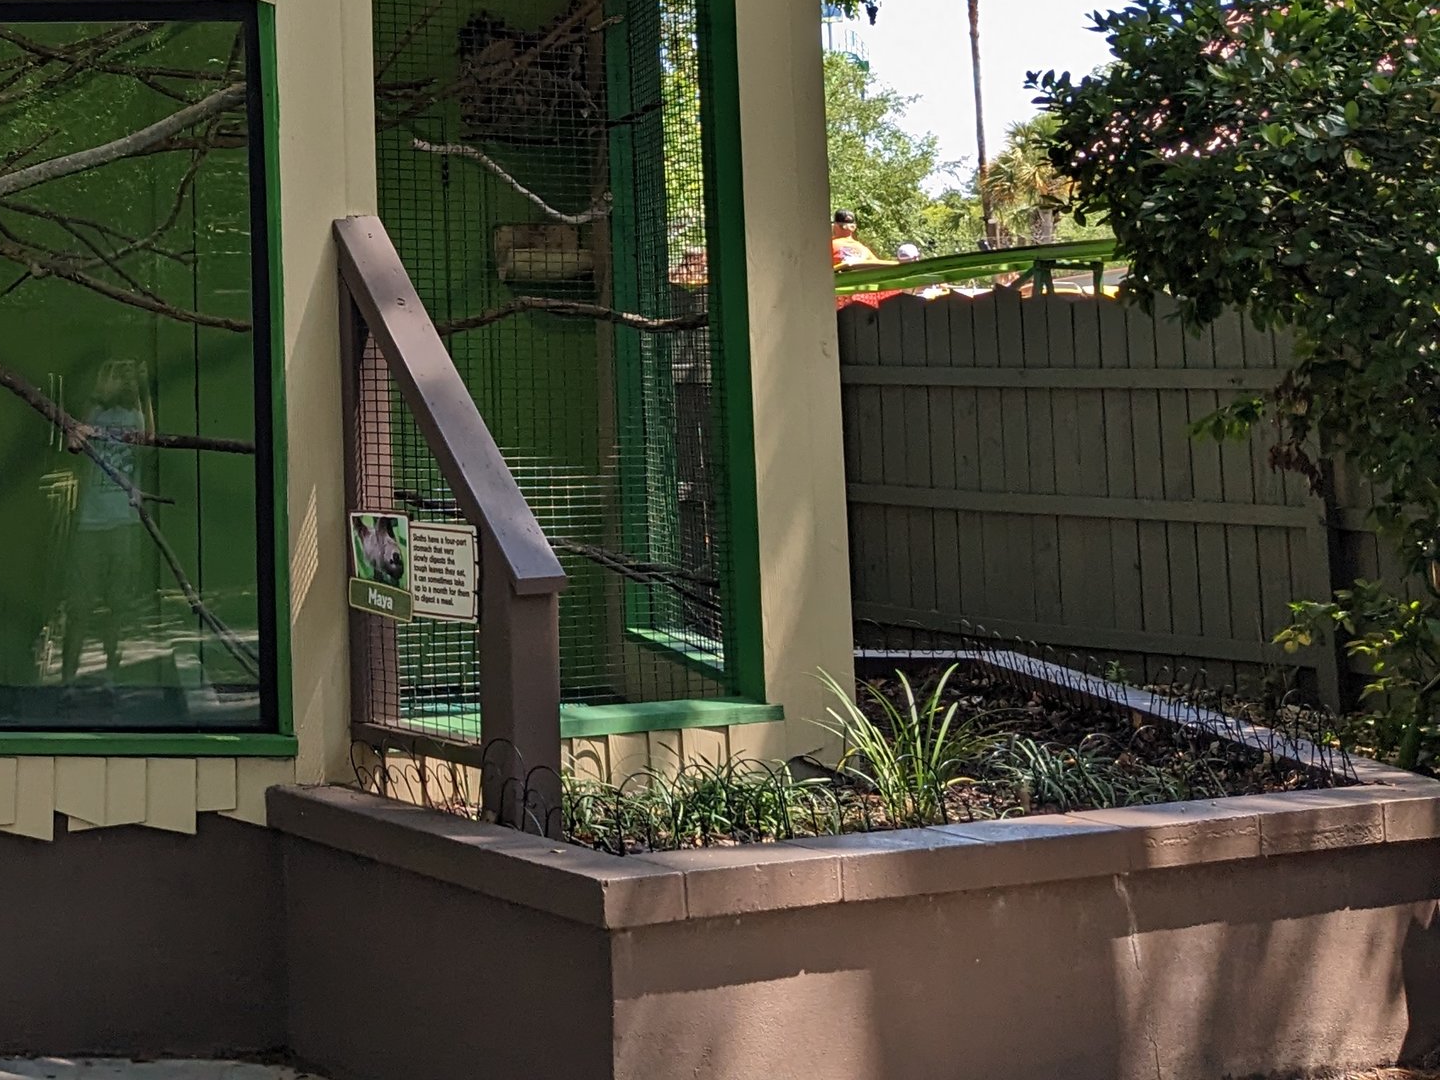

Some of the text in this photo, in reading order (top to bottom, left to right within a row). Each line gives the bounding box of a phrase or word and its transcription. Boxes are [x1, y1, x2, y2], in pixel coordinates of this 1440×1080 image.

[413, 534, 426, 542] Sloths
[428, 535, 439, 543] have
[445, 536, 466, 546] four-part
[433, 546, 442, 554] that
[429, 555, 446, 564] digests
[447, 557, 455, 565] the
[429, 565, 443, 574] leaves
[445, 567, 455, 575] they
[428, 577, 453, 585] sometimes
[368, 587, 393, 610] Maya
[421, 594, 435, 603] digest
